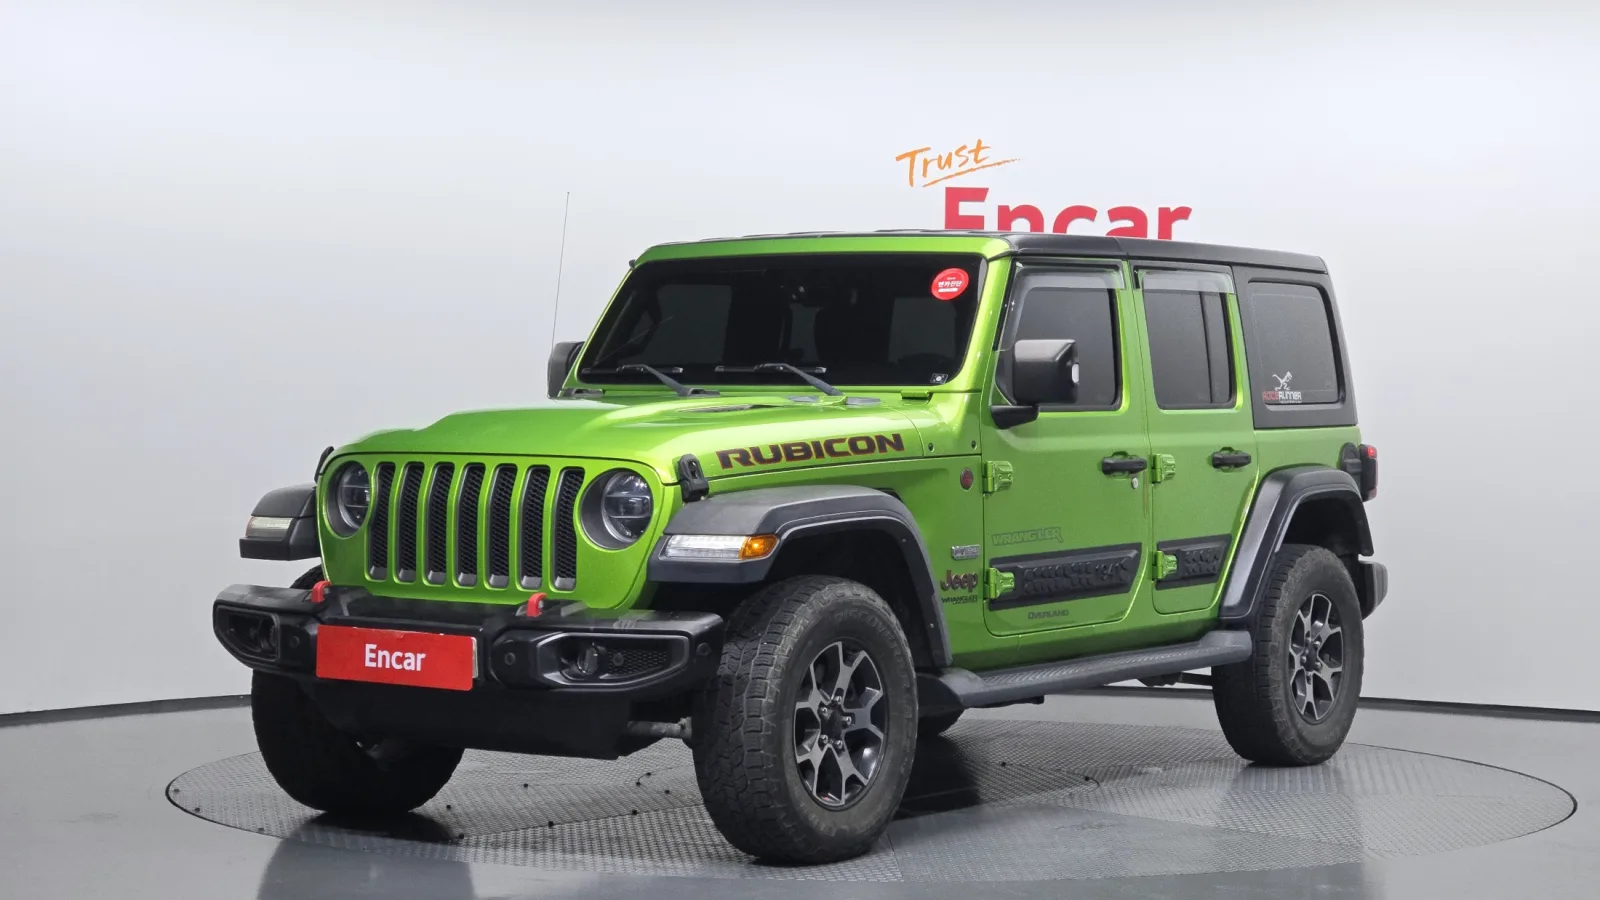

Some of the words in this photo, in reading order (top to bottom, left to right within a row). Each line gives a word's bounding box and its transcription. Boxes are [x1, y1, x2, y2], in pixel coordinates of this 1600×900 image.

[895, 138, 990, 187] Trust
[716, 433, 904, 470] RUBICON
[991, 526, 1063, 546] WRANGLER
[940, 569, 978, 593] Jeep
[1028, 609, 1069, 619] OVERLAND
[364, 643, 426, 671] Encar
